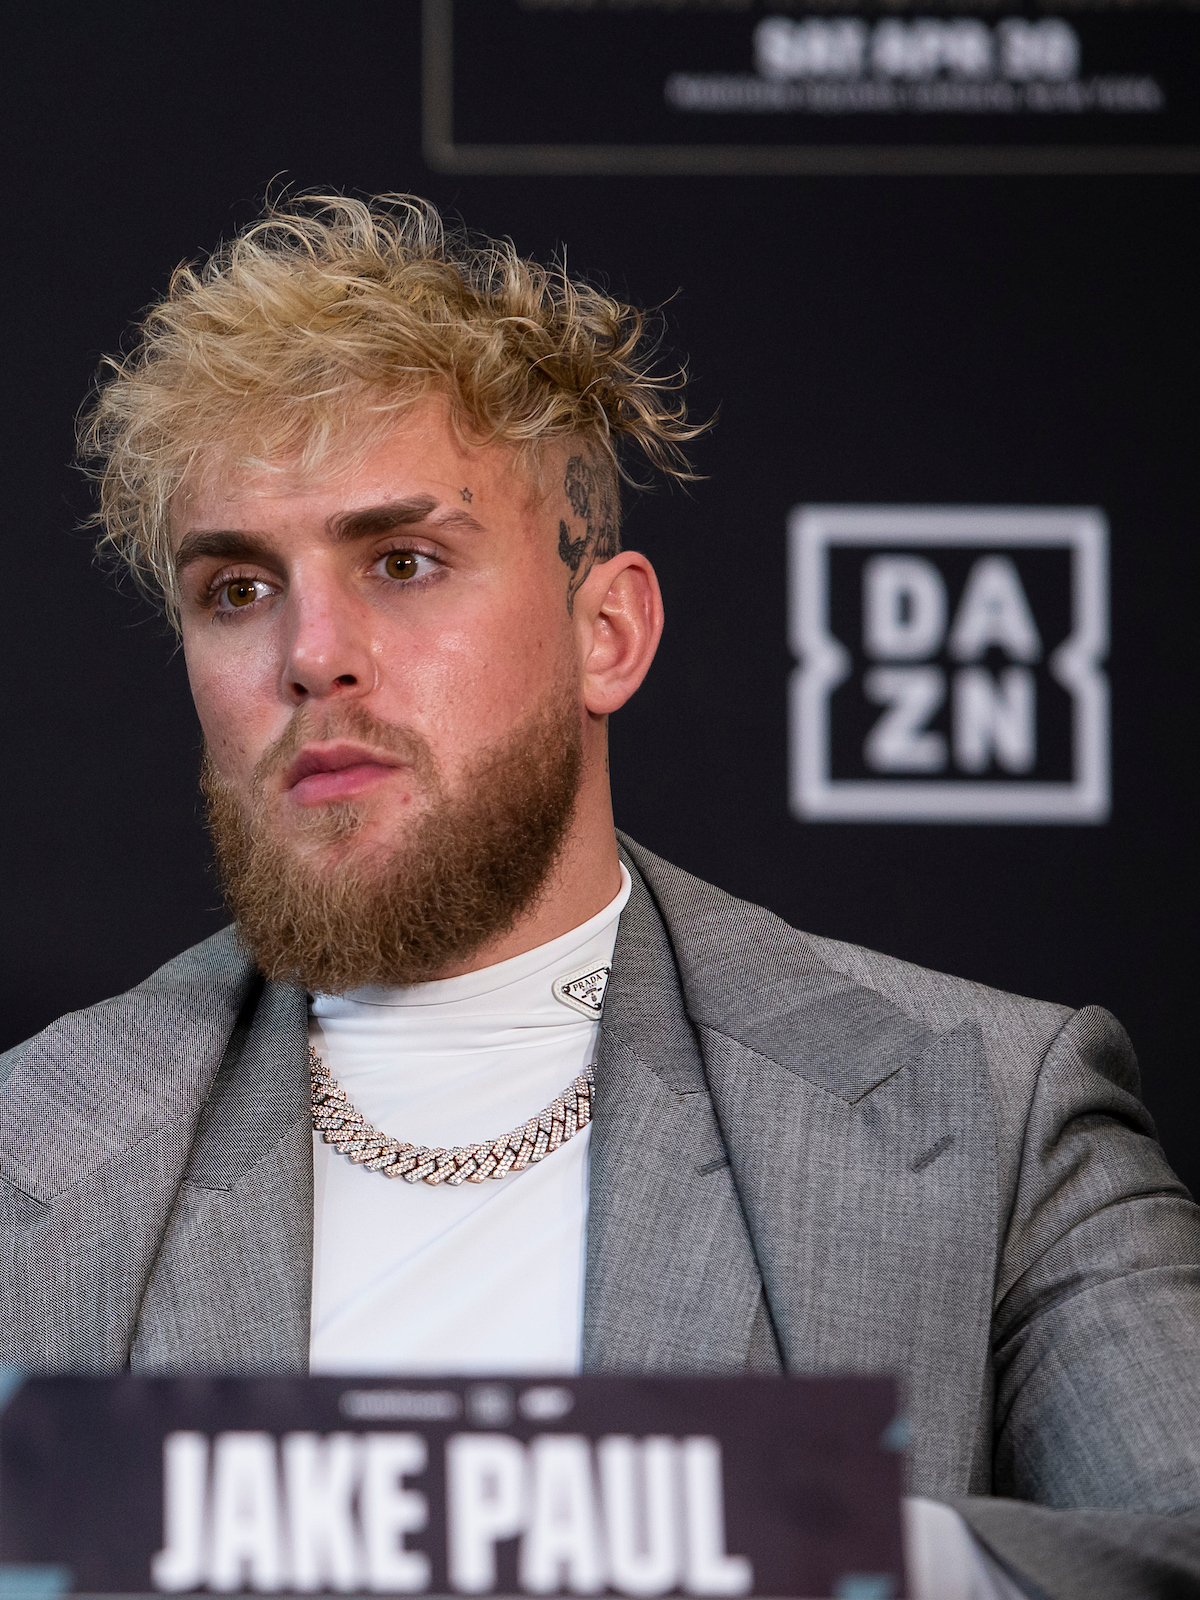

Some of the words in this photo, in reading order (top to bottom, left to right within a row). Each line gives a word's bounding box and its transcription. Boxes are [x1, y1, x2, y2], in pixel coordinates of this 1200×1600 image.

[572, 974, 603, 991] PRADA
[151, 1430, 431, 1594] JAKE
[445, 1433, 754, 1597] PAUL
